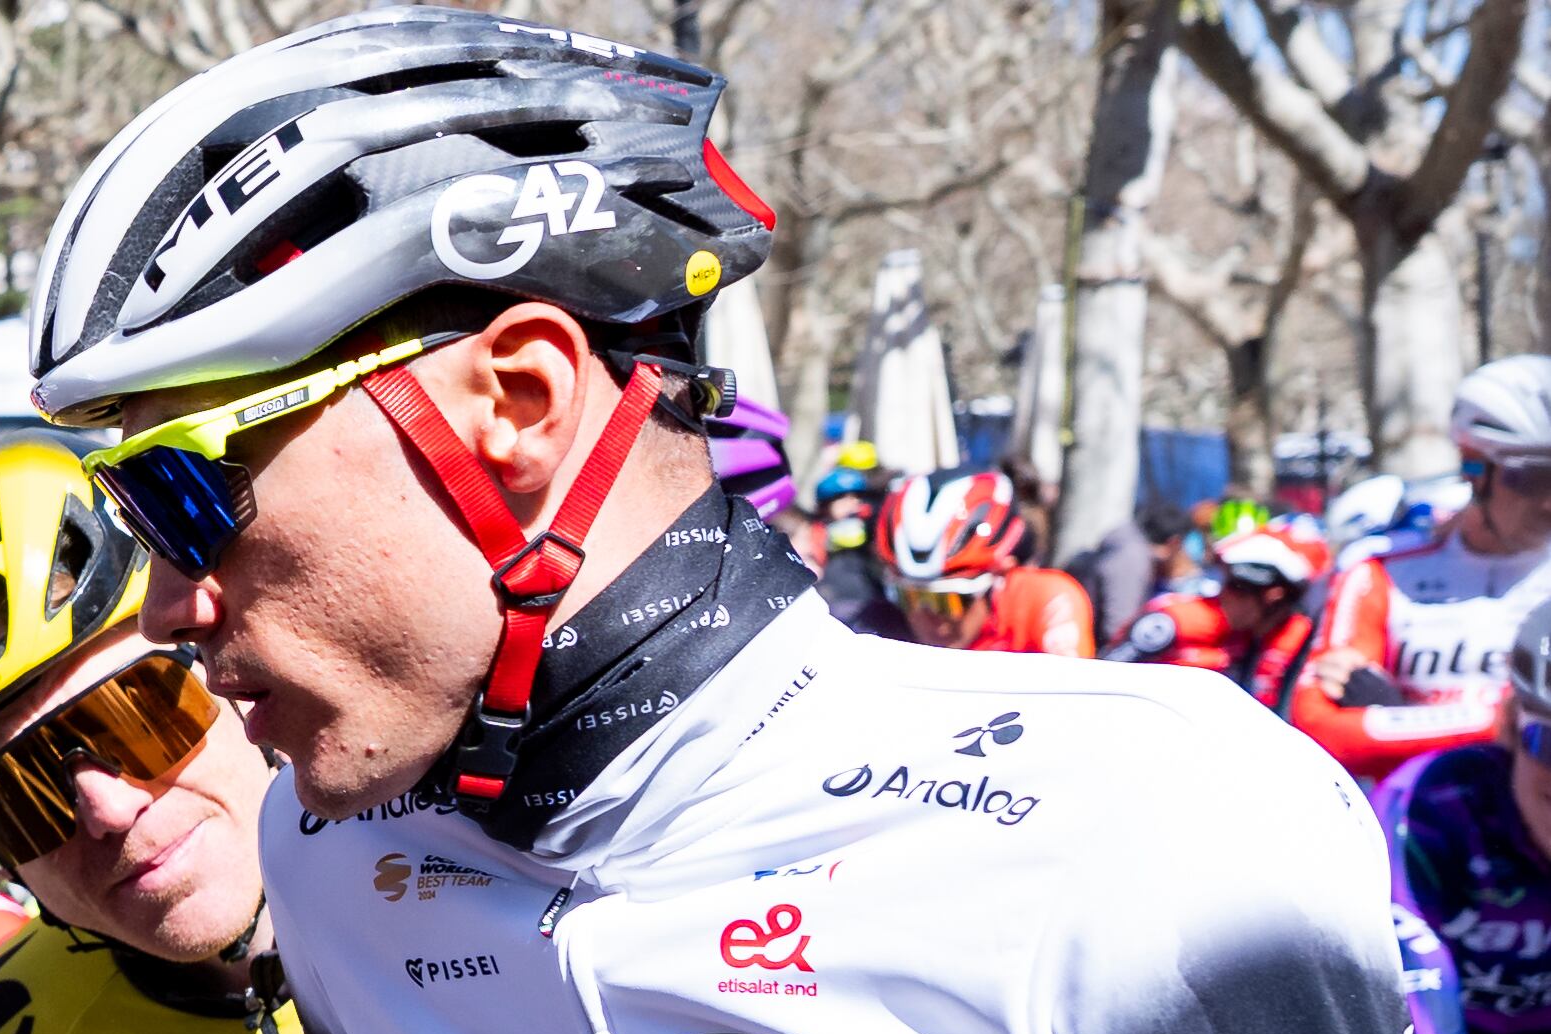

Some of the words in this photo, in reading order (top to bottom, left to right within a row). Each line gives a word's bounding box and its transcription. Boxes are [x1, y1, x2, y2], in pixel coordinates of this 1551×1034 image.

[144, 110, 320, 293] MET
[431, 160, 617, 280] G42
[577, 699, 653, 731] PISSEI
[524, 788, 576, 807] ISSEI
[871, 764, 1042, 826] Analog
[427, 954, 500, 983] PISSEI
[718, 977, 780, 997] etisalat
[784, 982, 818, 998] and
